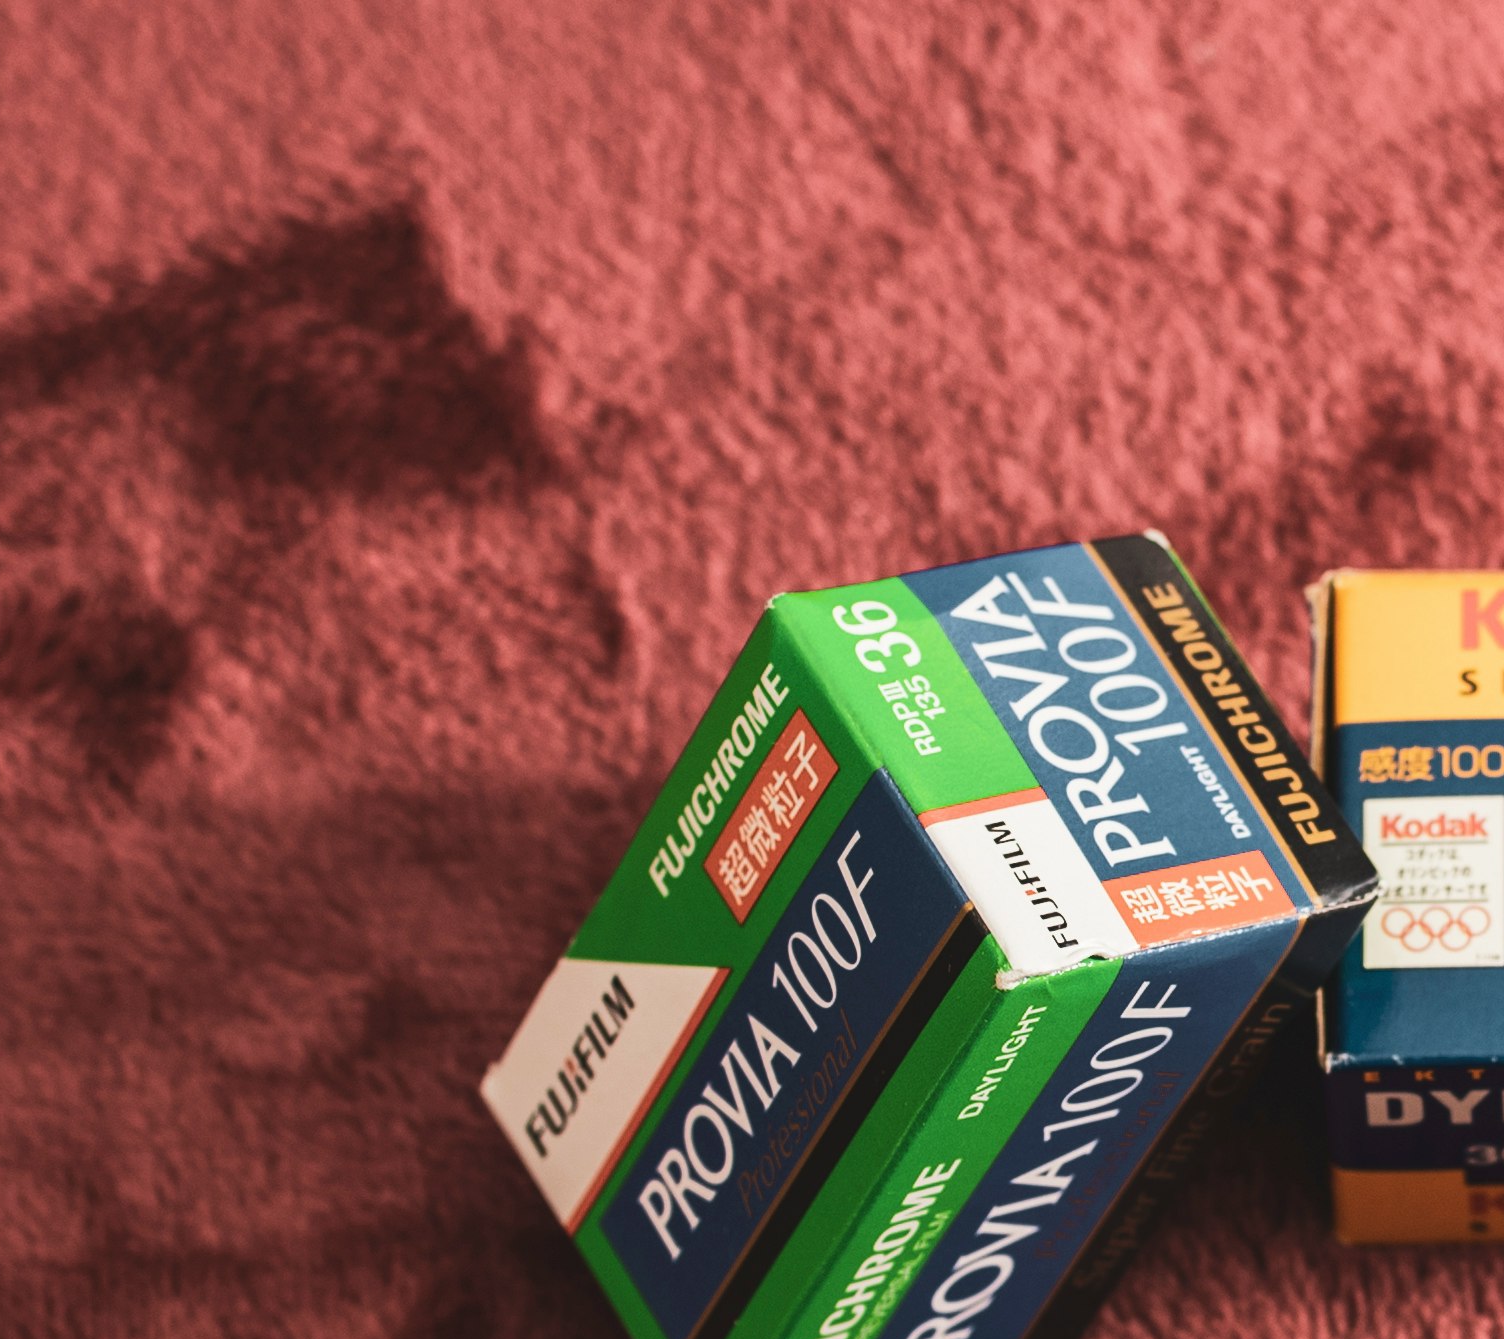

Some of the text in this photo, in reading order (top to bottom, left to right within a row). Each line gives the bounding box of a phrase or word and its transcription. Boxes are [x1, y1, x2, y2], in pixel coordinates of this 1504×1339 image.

[832, 598, 922, 678] 36
[913, 674, 949, 721] 135
[949, 571, 1178, 866] PROVIA
[1029, 575, 1190, 756] 100F
[1142, 581, 1337, 846] FUJICHROME
[648, 663, 791, 897] FUJICHROME
[718, 730, 819, 905] 超微粒子
[1179, 746, 1253, 840] DAYLIGHT
[1380, 813, 1489, 840] Kodak
[983, 820, 1080, 950] FUJIFILM
[1120, 866, 1274, 926] 超微粒子
[523, 974, 637, 1158] FUJIFILM
[638, 830, 878, 1262] PROVIA 100F
[737, 1009, 860, 1218] Professional
[957, 1004, 1048, 1120] DAYLIGHT
[1043, 980, 1192, 1142] 100F
